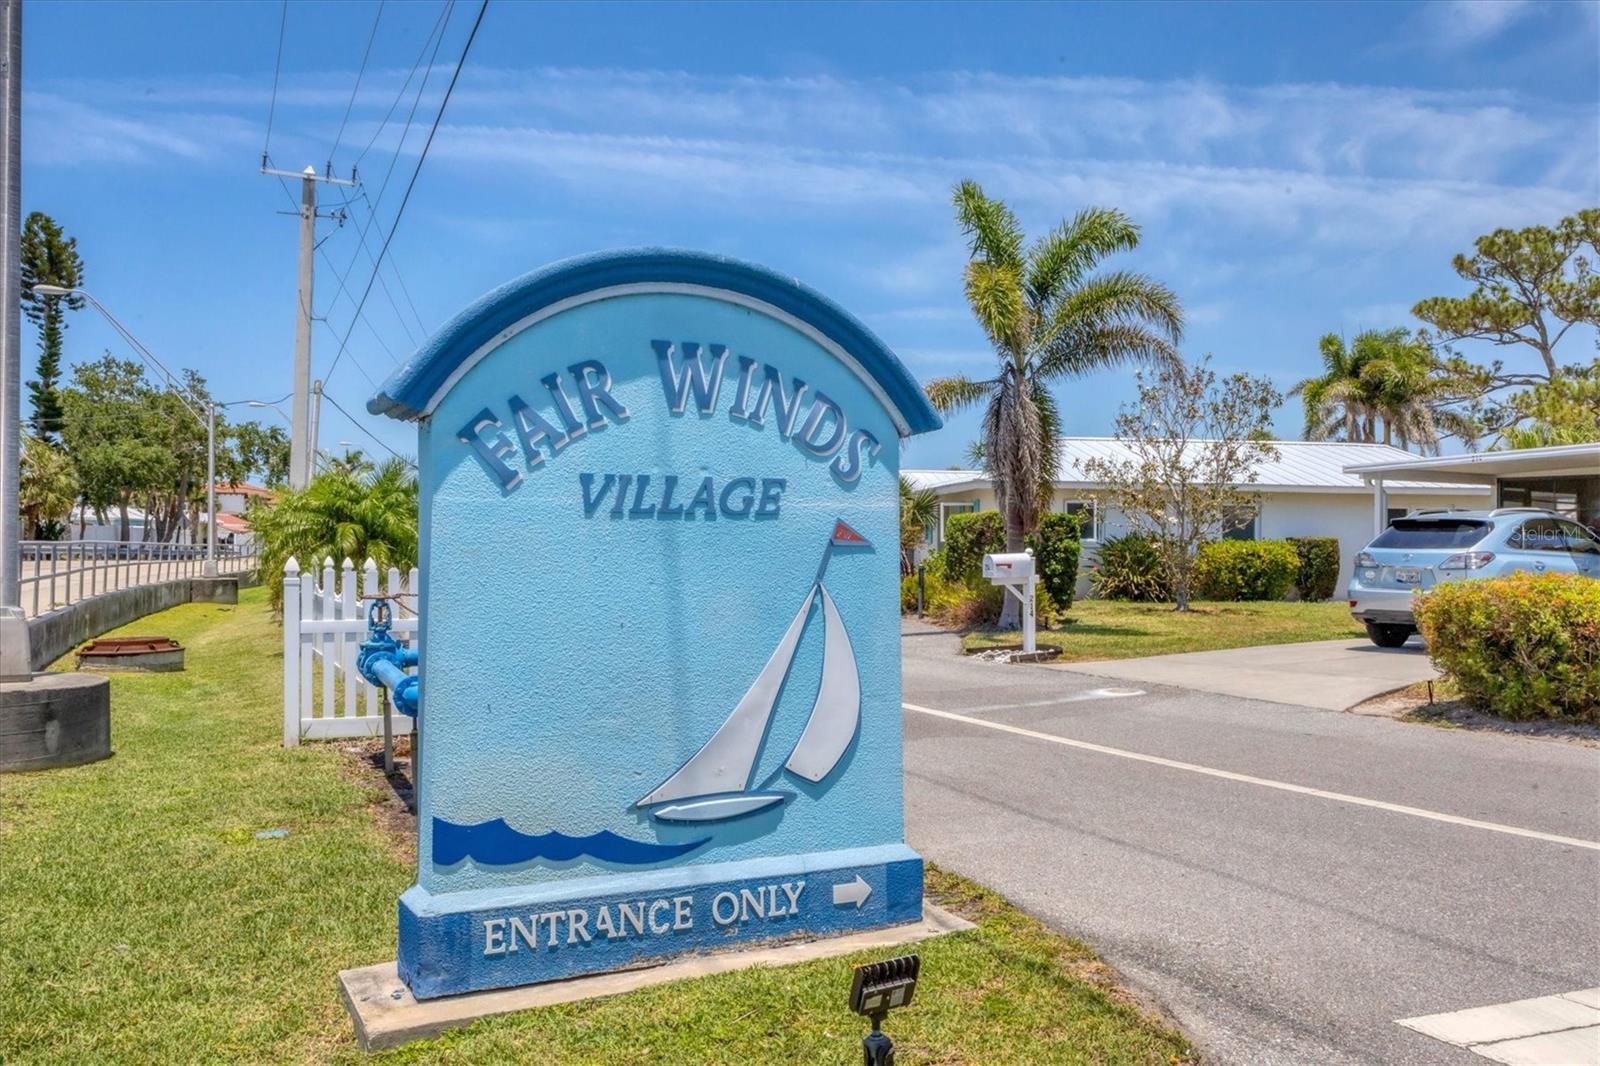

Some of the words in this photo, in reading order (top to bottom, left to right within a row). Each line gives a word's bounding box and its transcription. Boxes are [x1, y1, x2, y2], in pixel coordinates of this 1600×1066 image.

[457, 359, 631, 492] FAIR
[651, 339, 882, 485] WINDS
[579, 473, 788, 519] VILLAGE
[483, 895, 694, 956] ENTRANCE
[711, 880, 807, 926] ONLY
